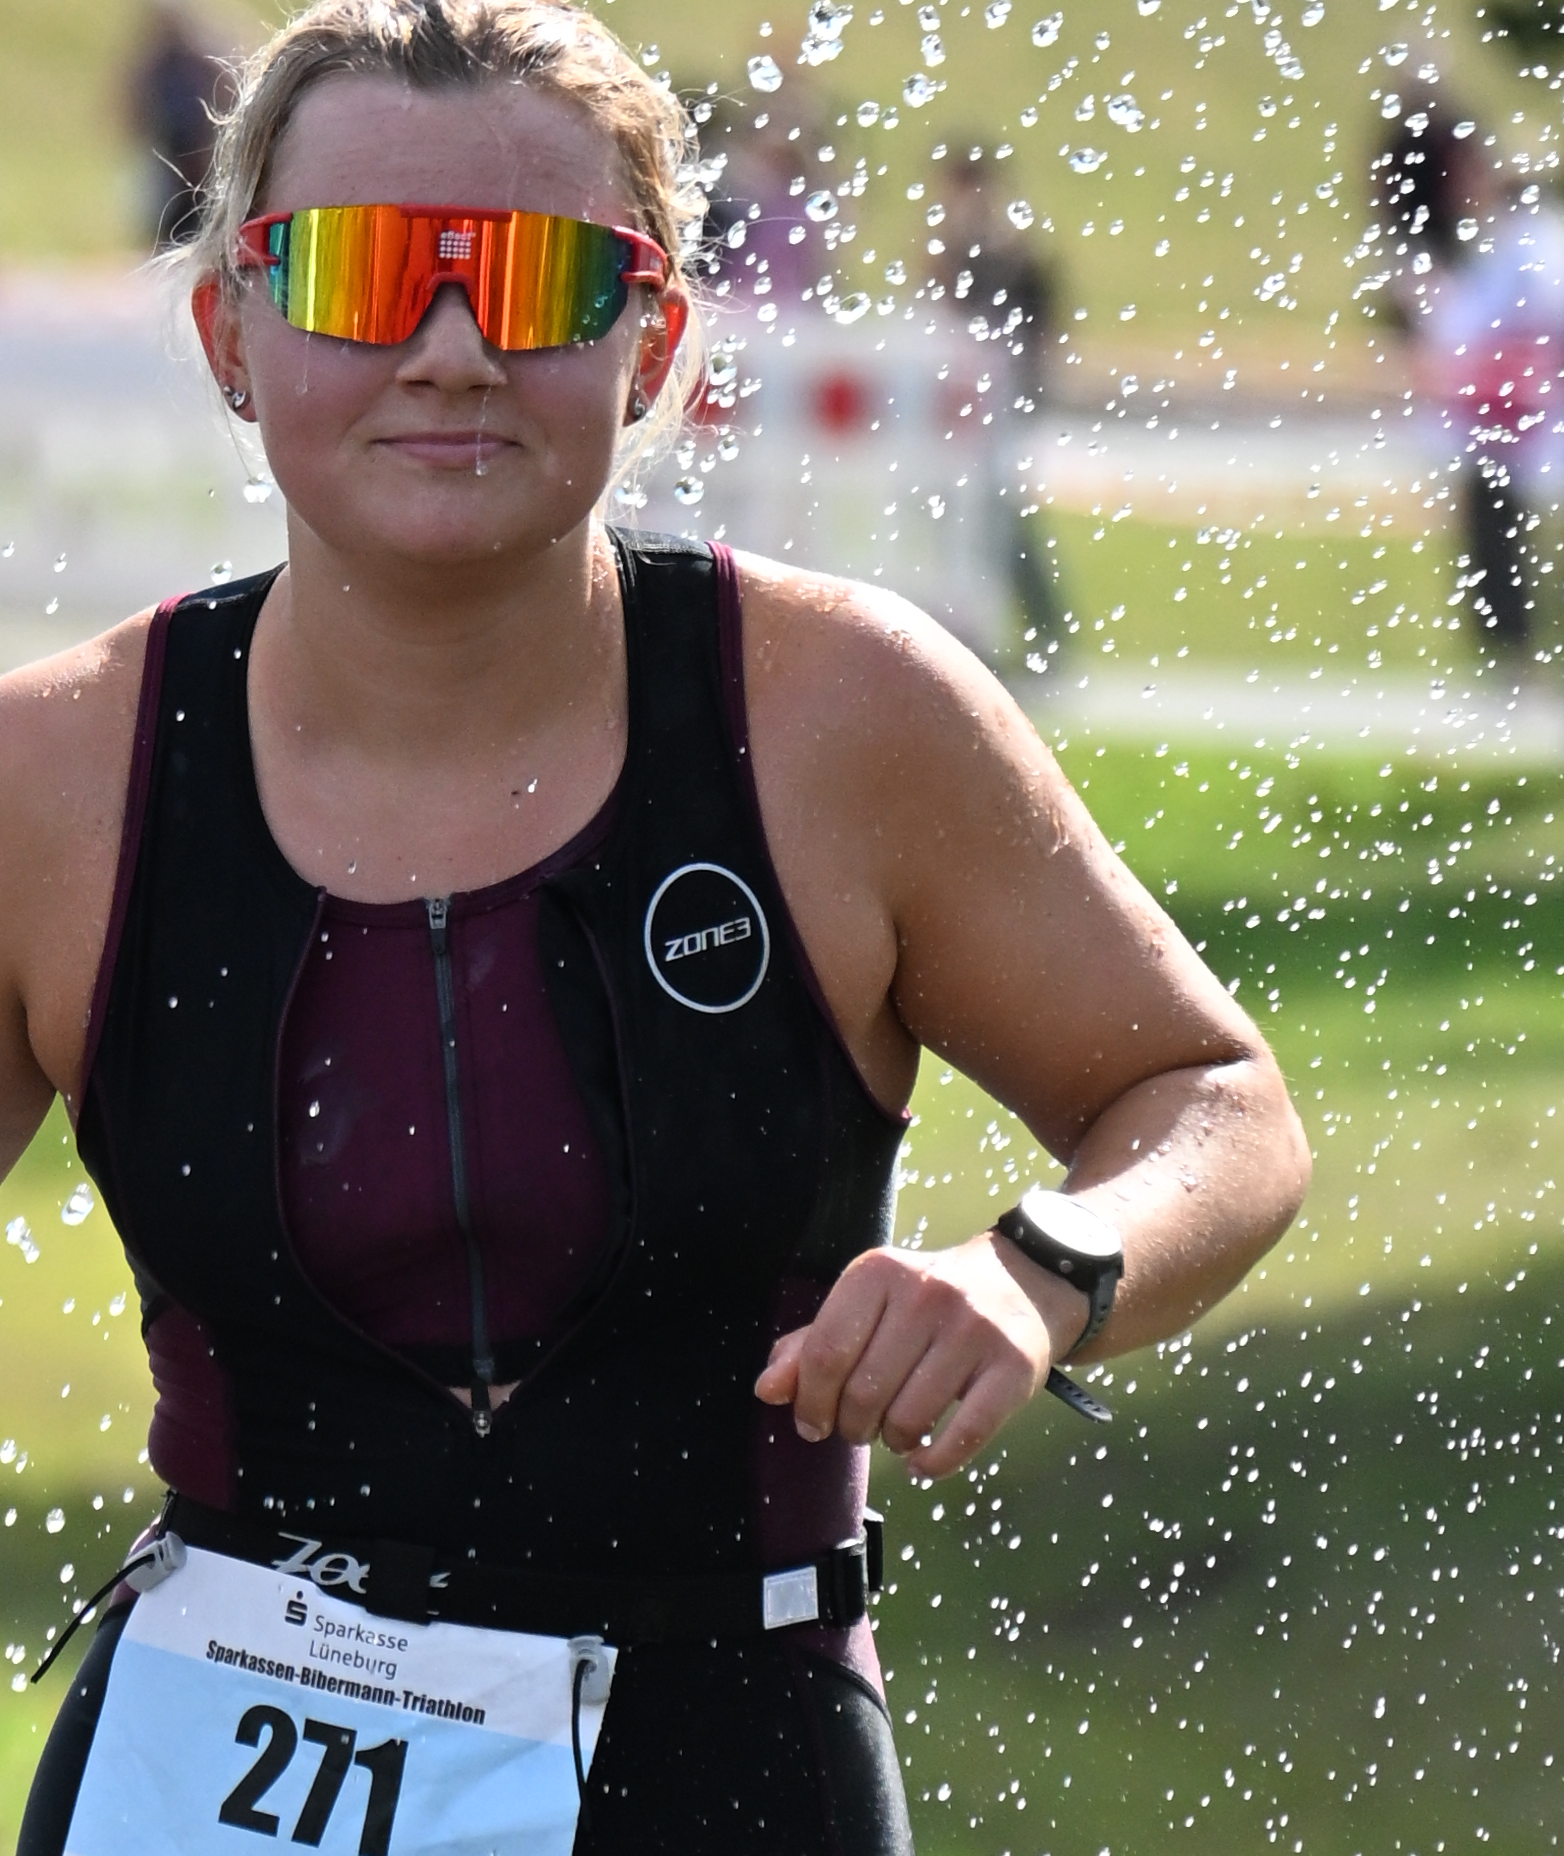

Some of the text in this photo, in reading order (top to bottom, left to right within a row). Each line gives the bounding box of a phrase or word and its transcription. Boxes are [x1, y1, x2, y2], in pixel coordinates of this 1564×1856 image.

[664, 916, 752, 963] ZONE3
[313, 1614, 409, 1652] Sparkasse
[309, 1640, 398, 1680] Lüneburg
[206, 1639, 486, 1726] Sparkassen-Bibermann-Triathlon
